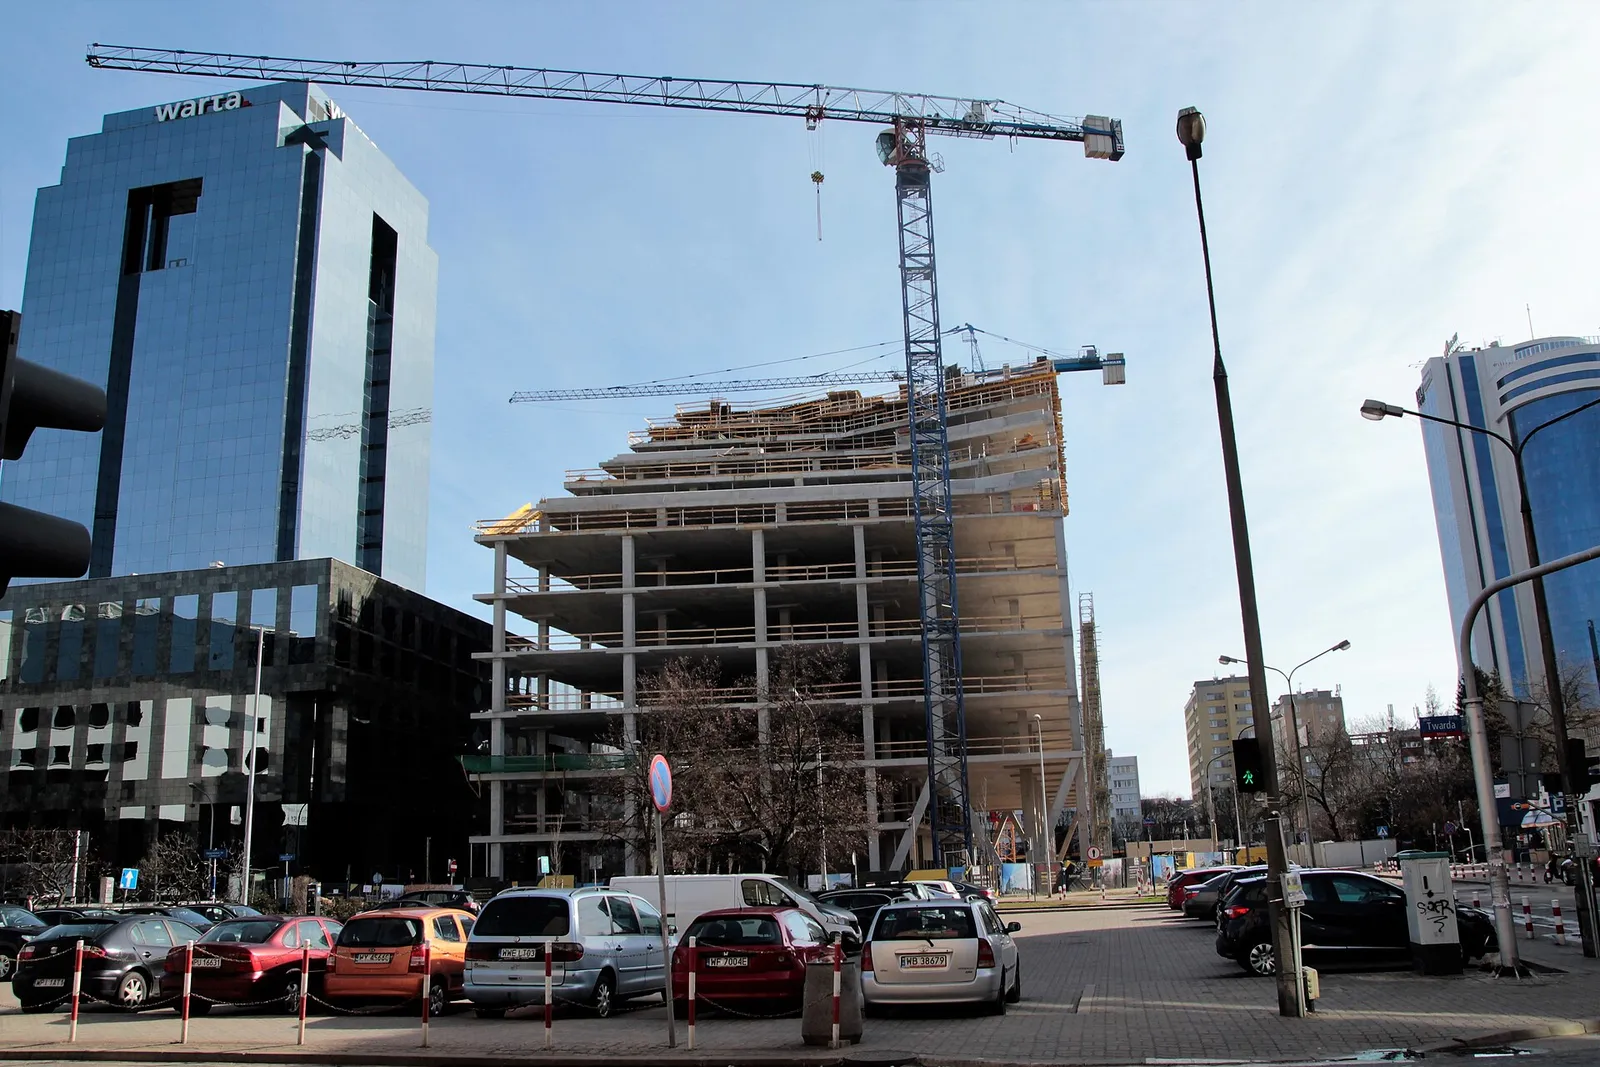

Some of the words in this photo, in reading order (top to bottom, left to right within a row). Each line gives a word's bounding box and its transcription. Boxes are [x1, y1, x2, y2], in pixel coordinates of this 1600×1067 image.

[155, 91, 241, 122] warta
[1427, 721, 1456, 730] Twarda
[502, 949, 516, 957] WWE
[906, 957, 918, 965] WB
[920, 956, 945, 965] 38679
